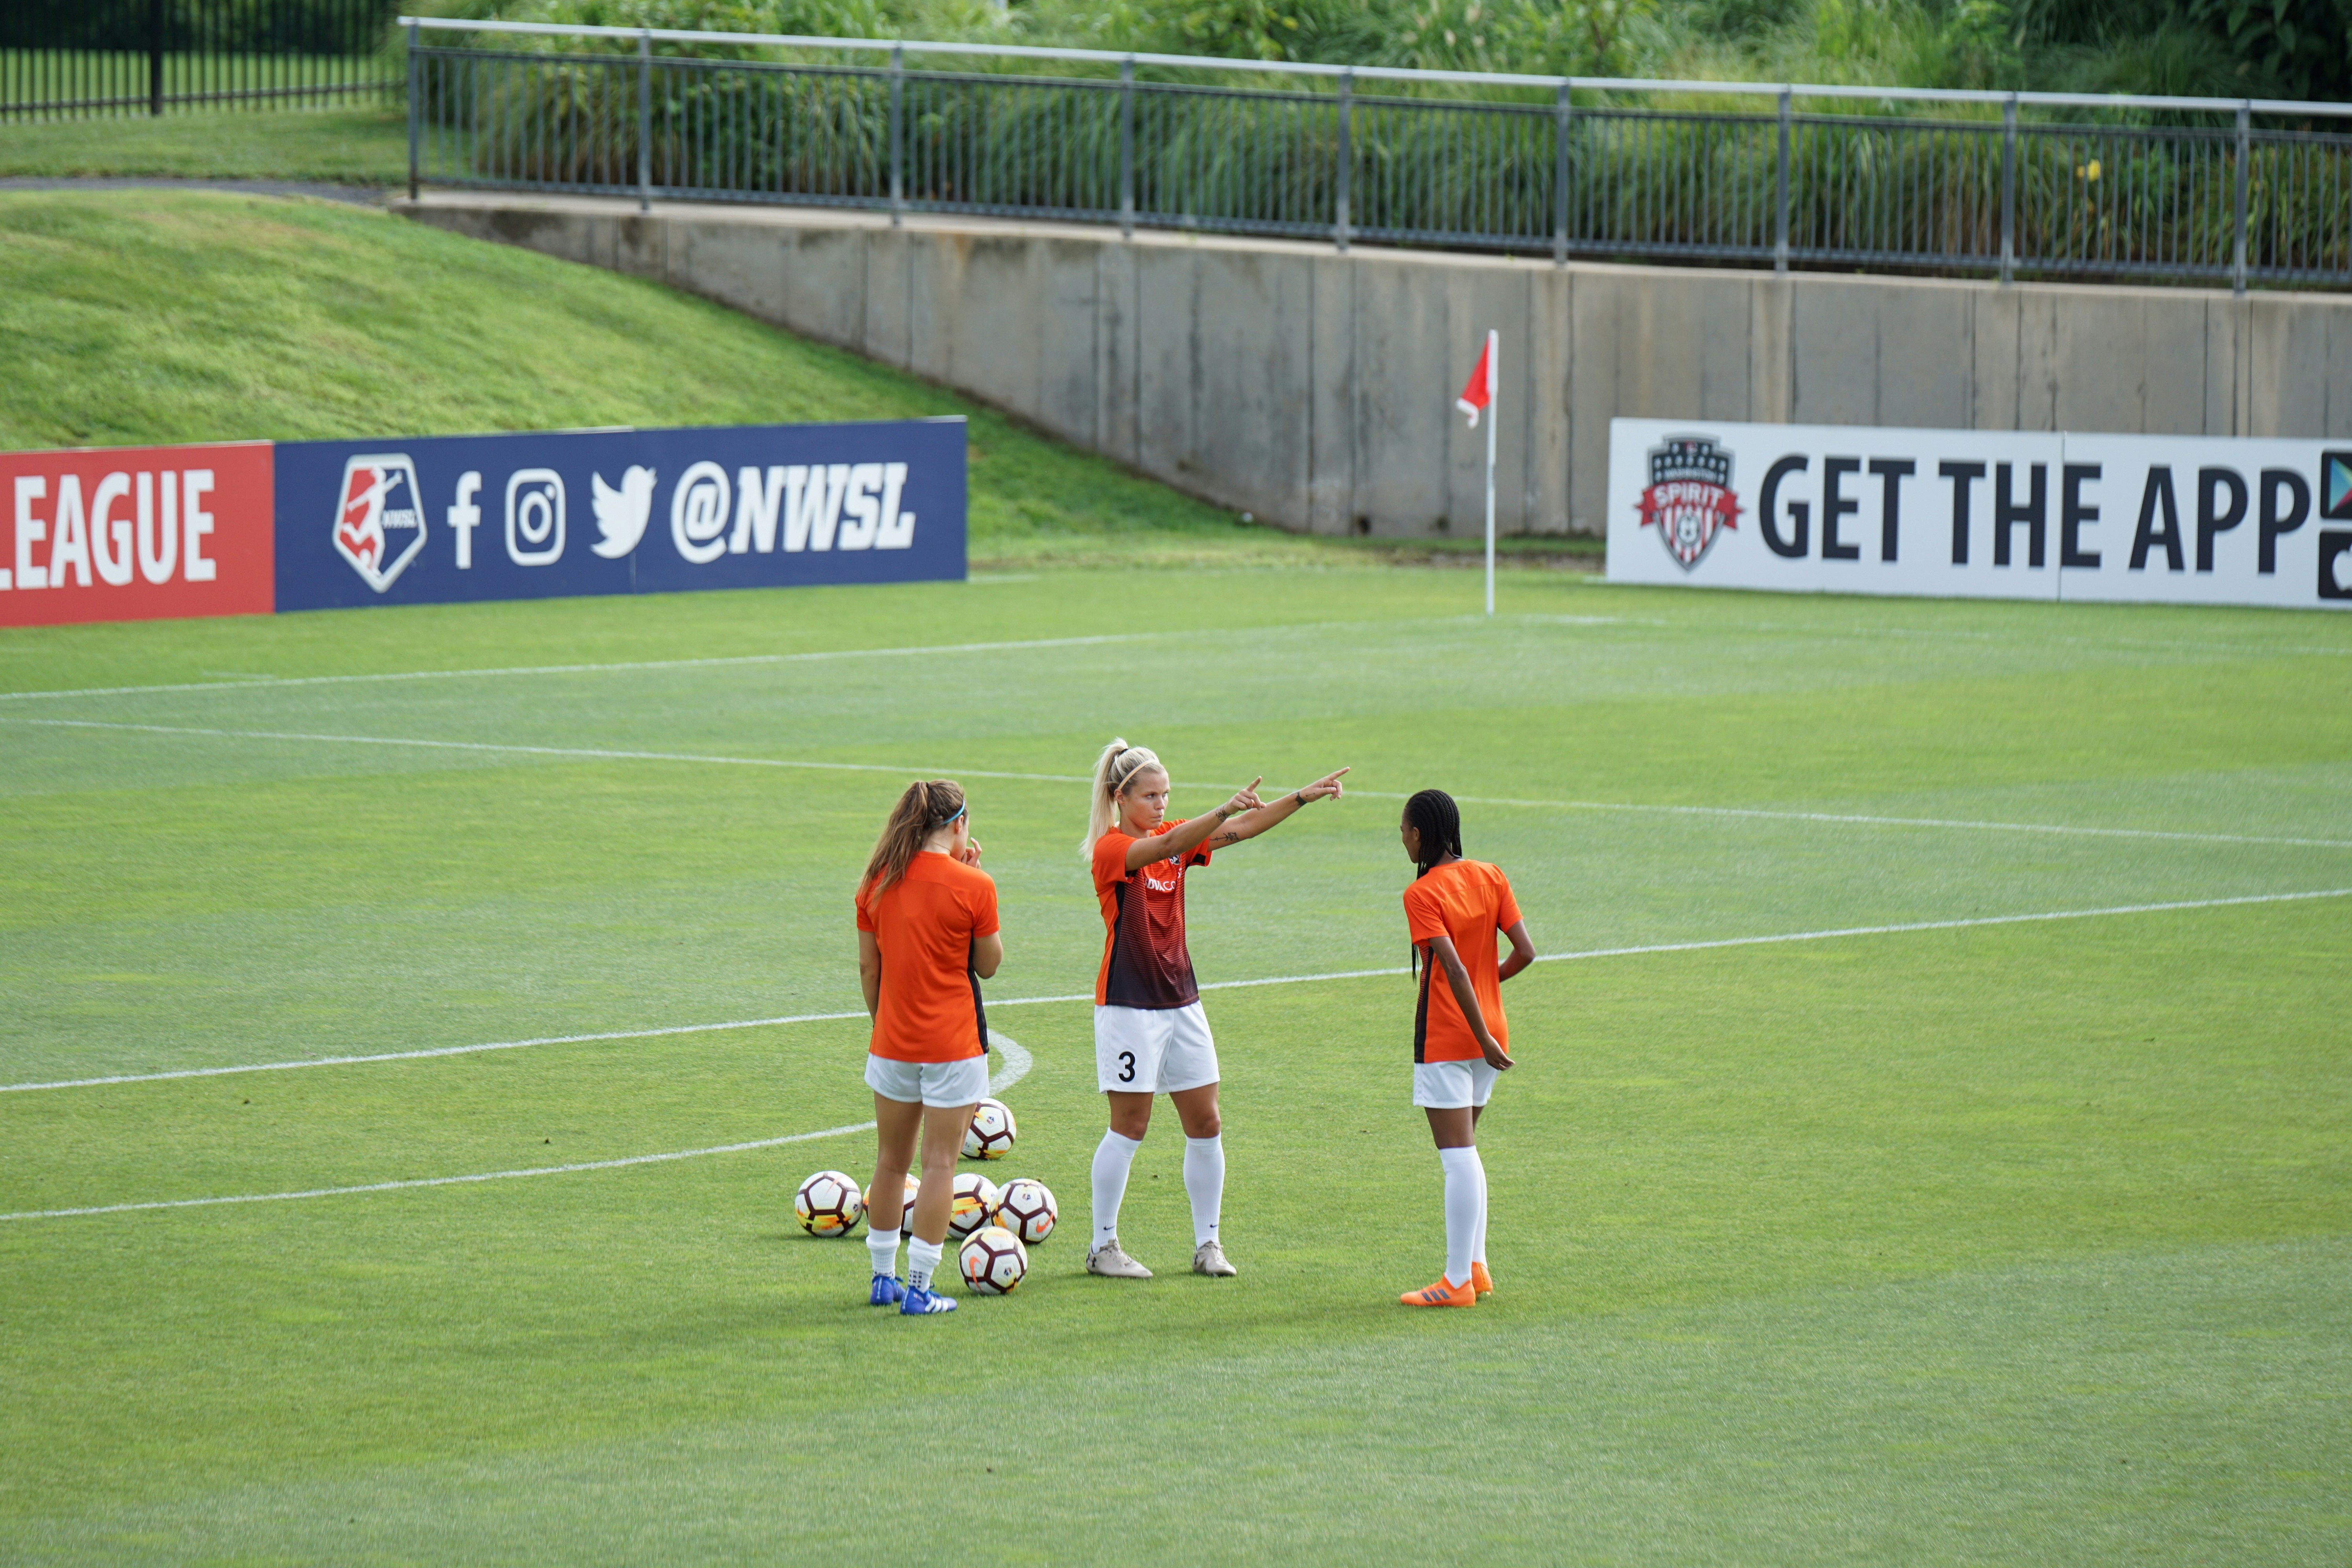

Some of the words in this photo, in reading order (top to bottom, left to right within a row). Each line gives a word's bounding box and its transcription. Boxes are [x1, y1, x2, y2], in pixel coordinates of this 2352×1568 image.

[670, 461, 916, 564] @NWSL
[1653, 481, 1725, 510] SPIRIT
[1759, 454, 1916, 562] GET
[1938, 458, 2102, 568] THE
[2128, 463, 2311, 575] APP
[1118, 1051, 1135, 1082] 3
